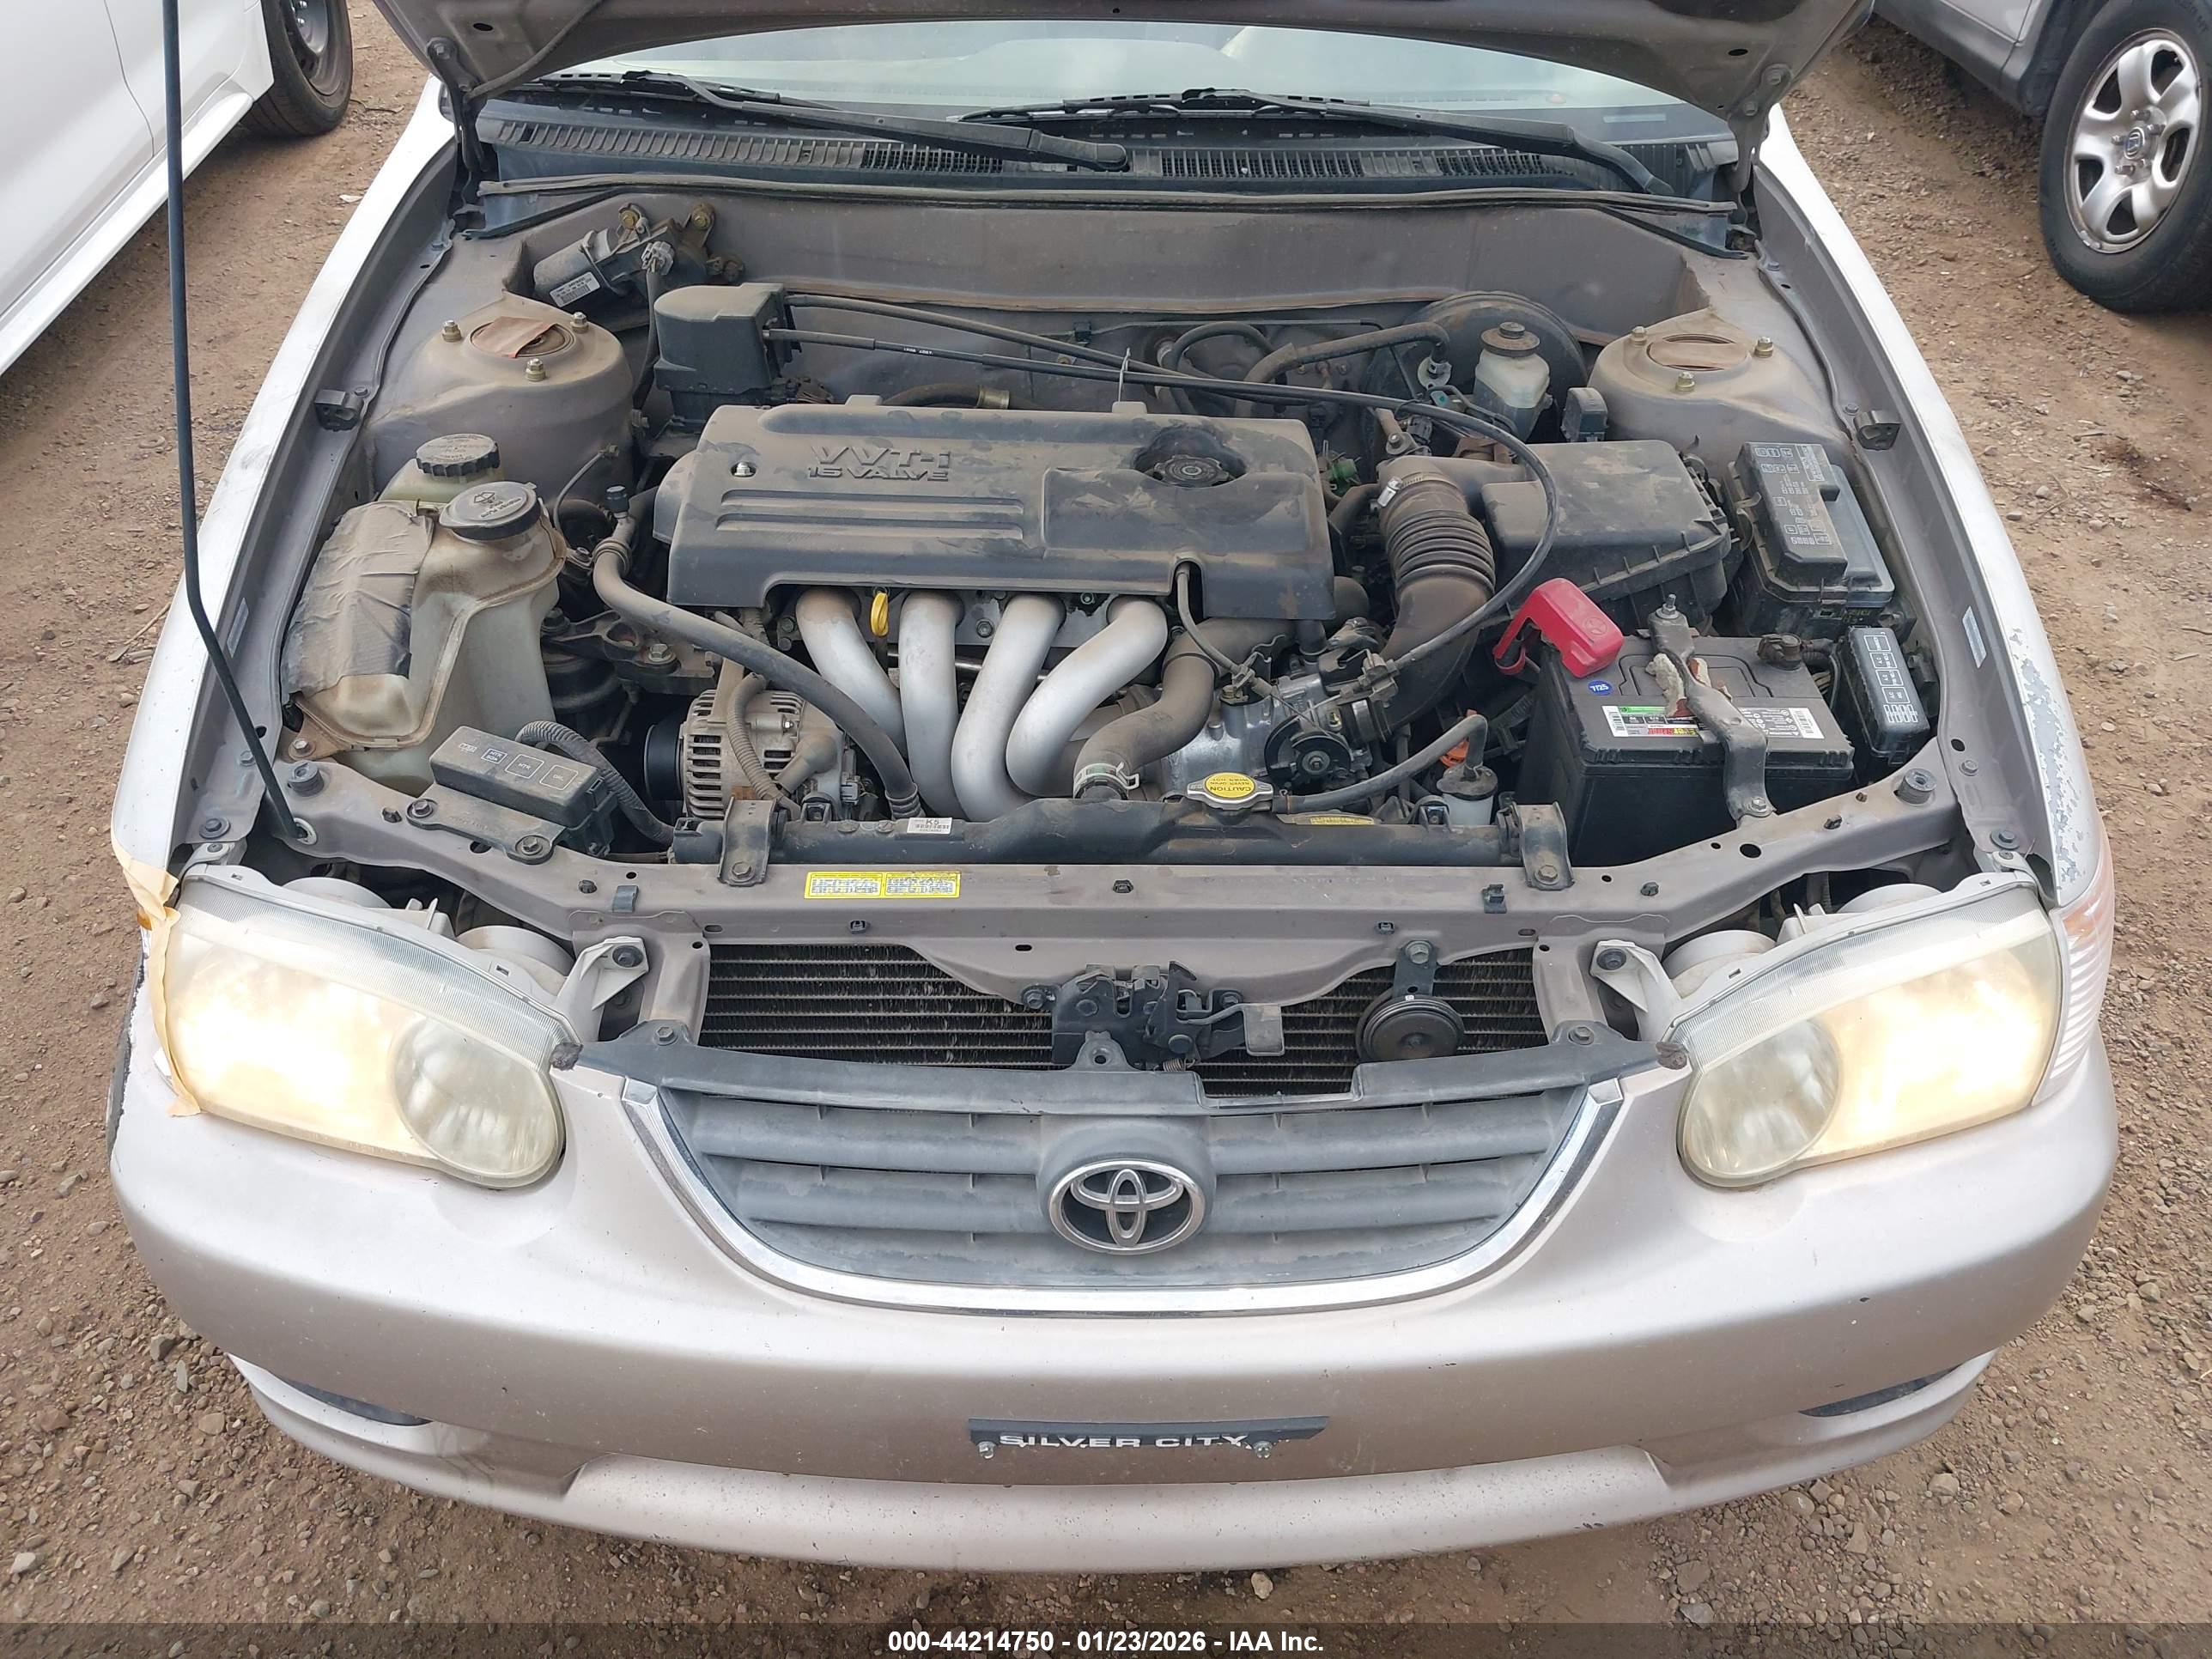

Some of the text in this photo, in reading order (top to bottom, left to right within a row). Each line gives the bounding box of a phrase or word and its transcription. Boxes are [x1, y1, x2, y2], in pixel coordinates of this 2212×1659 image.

[847, 467, 949, 482] VALVE
[1000, 1435, 1250, 1449] SILVER CITY
